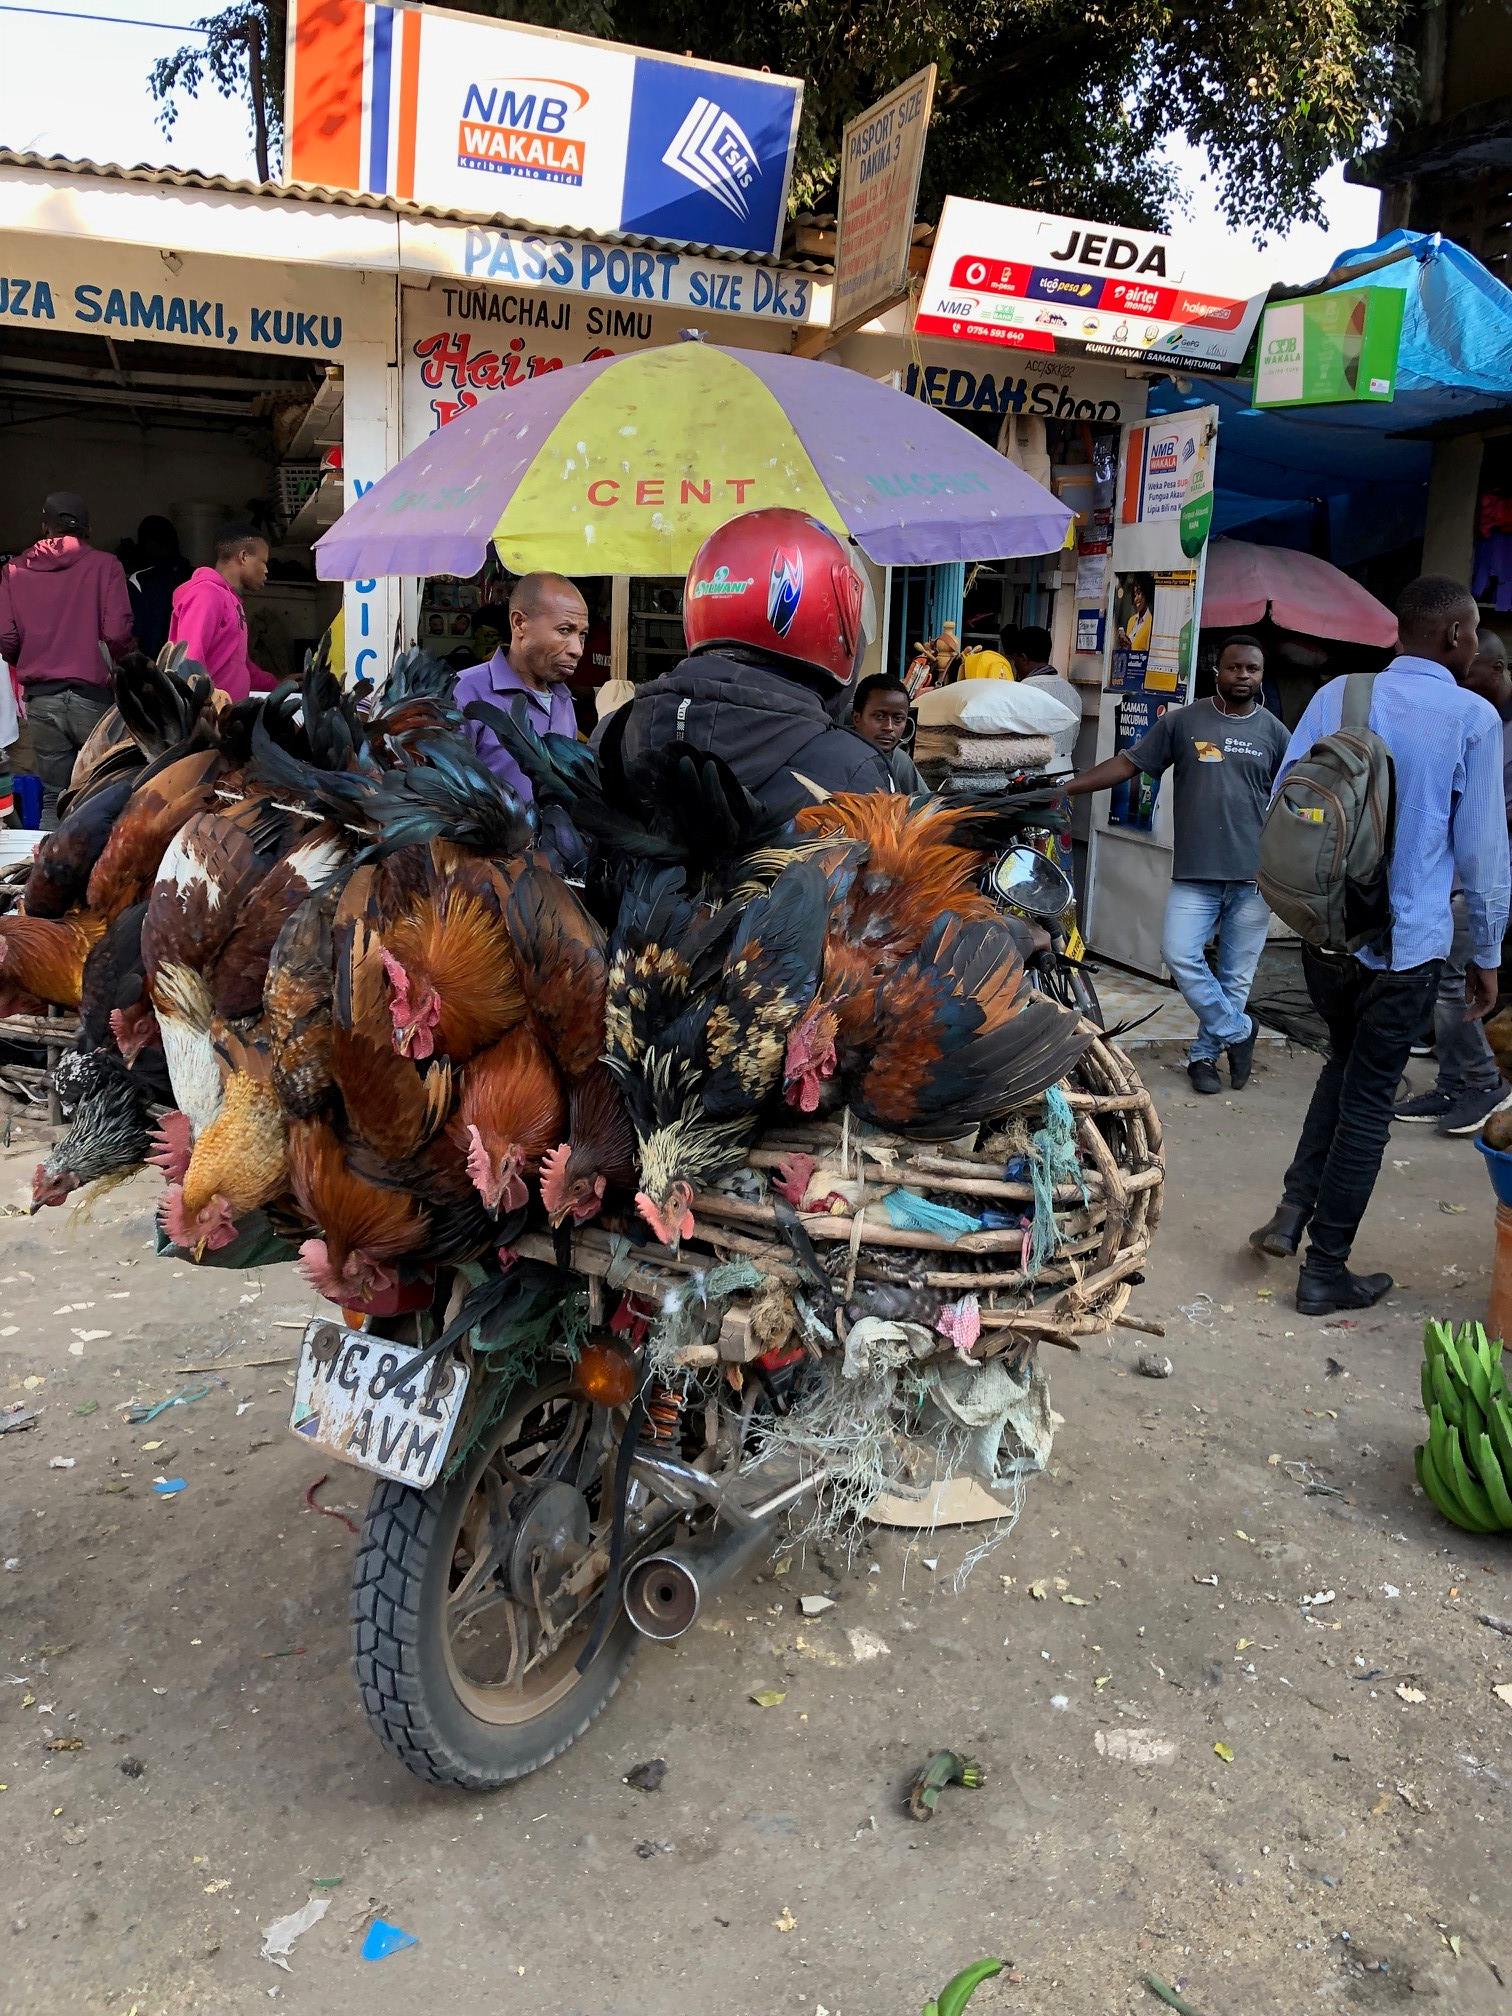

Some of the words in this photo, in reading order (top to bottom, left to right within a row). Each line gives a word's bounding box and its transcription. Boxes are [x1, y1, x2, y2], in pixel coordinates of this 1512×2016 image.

[462, 83, 568, 134] NMB
[850, 109, 895, 163] PASPORT
[898, 89, 922, 129] SIZE
[463, 127, 580, 171] WAKALA
[719, 134, 753, 188] Tshs
[860, 141, 890, 183] DAKIKA
[893, 134, 901, 161] 3
[460, 157, 503, 172] Karibu
[510, 167, 539, 180] yako
[546, 173, 577, 185] zaidi
[1050, 231, 1166, 277] JEDA
[464, 225, 680, 300] PASSPORT
[689, 271, 742, 312] SIZE
[937, 300, 972, 316] NMB
[1124, 301, 1154, 313] money
[1126, 287, 1158, 304] airtel
[74, 284, 239, 344] SAMAKI,
[251, 308, 343, 348] KUKU
[441, 288, 570, 331] TUNACHAJI
[587, 307, 652, 340] SIMU
[1085, 342, 1111, 354] KUKU
[1147, 352, 1179, 365] SAMAKI
[1184, 357, 1221, 371] MITUMBA
[1264, 352, 1301, 365] WAKALA
[1150, 457, 1176, 470] WAKALA
[1151, 442, 1174, 457] NMB
[587, 479, 756, 507] CENT
[1120, 713, 1148, 726] MKUBWA
[1121, 701, 1148, 714] KAMATA
[1120, 726, 1135, 737] WAO
[1225, 738, 1252, 747] Star
[1224, 745, 1263, 757] Seeker
[347, 1408, 439, 1478] AVM
